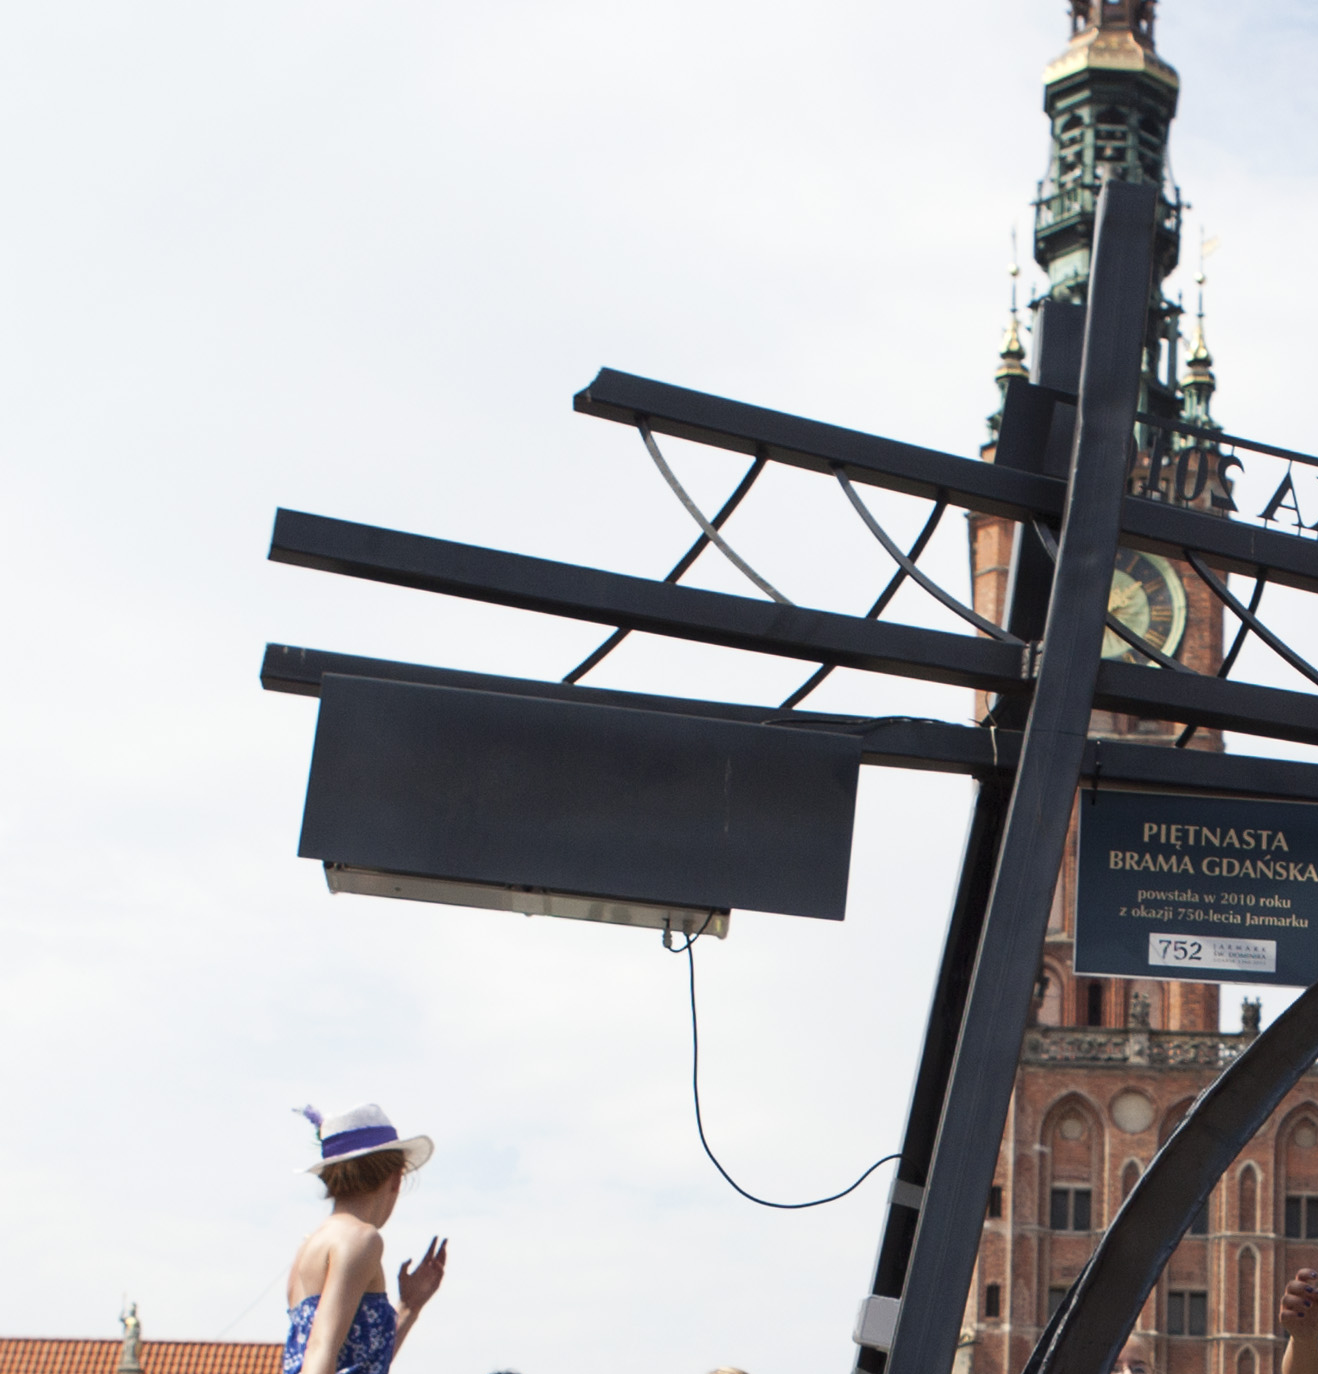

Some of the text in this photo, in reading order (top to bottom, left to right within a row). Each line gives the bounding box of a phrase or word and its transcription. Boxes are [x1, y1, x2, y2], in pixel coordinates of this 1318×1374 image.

[1143, 822, 1289, 851] PIĘTNASTA
[1109, 850, 1195, 875] BRAMA
[1137, 888, 1291, 909] powstała w 2010 roku
[1119, 904, 1309, 928] z okazji 750-lecia Jarmarku
[1158, 939, 1203, 961] 752
